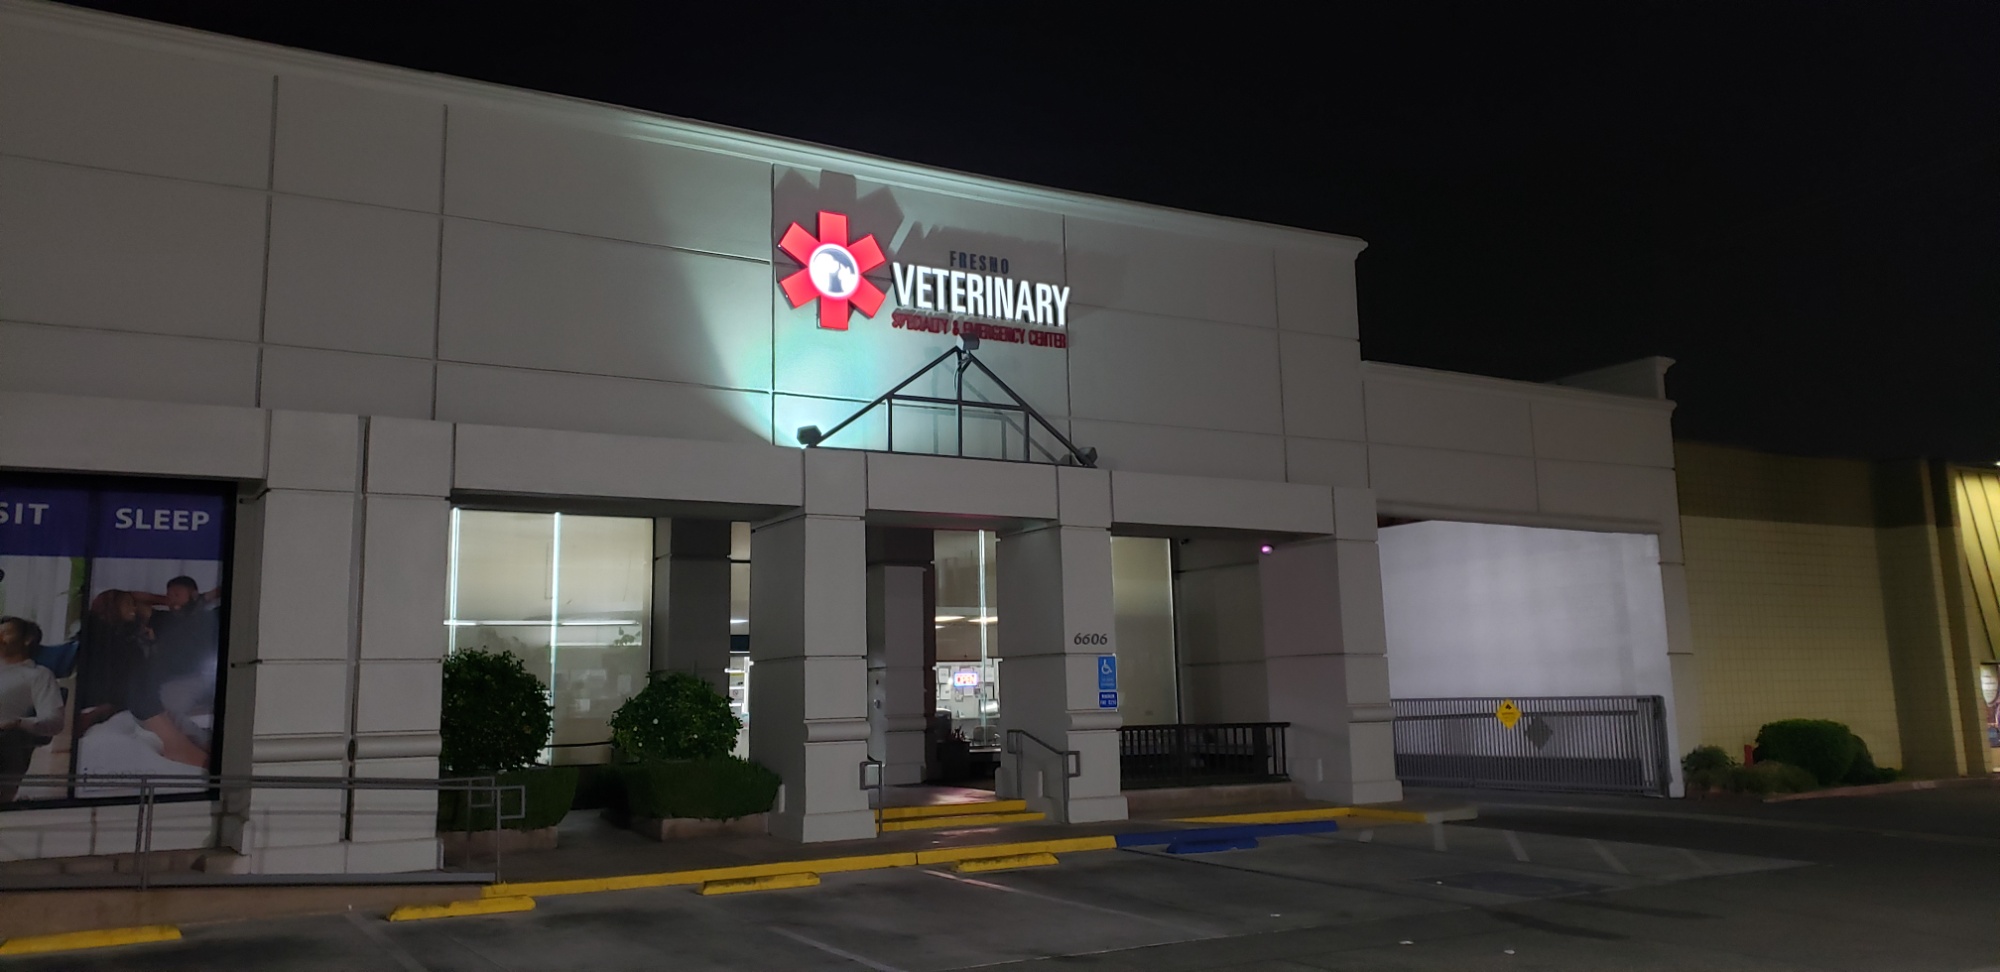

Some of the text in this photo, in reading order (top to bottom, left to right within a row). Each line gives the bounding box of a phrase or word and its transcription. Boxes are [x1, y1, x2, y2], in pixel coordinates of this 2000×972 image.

[950, 251, 1009, 274] FRESNO
[892, 262, 1070, 327] VETERINARY
[891, 312, 1067, 348] SPECIALTY & EMERGENCY CENTER
[115, 508, 210, 532] SLEEP
[1073, 632, 1108, 646] 6606
